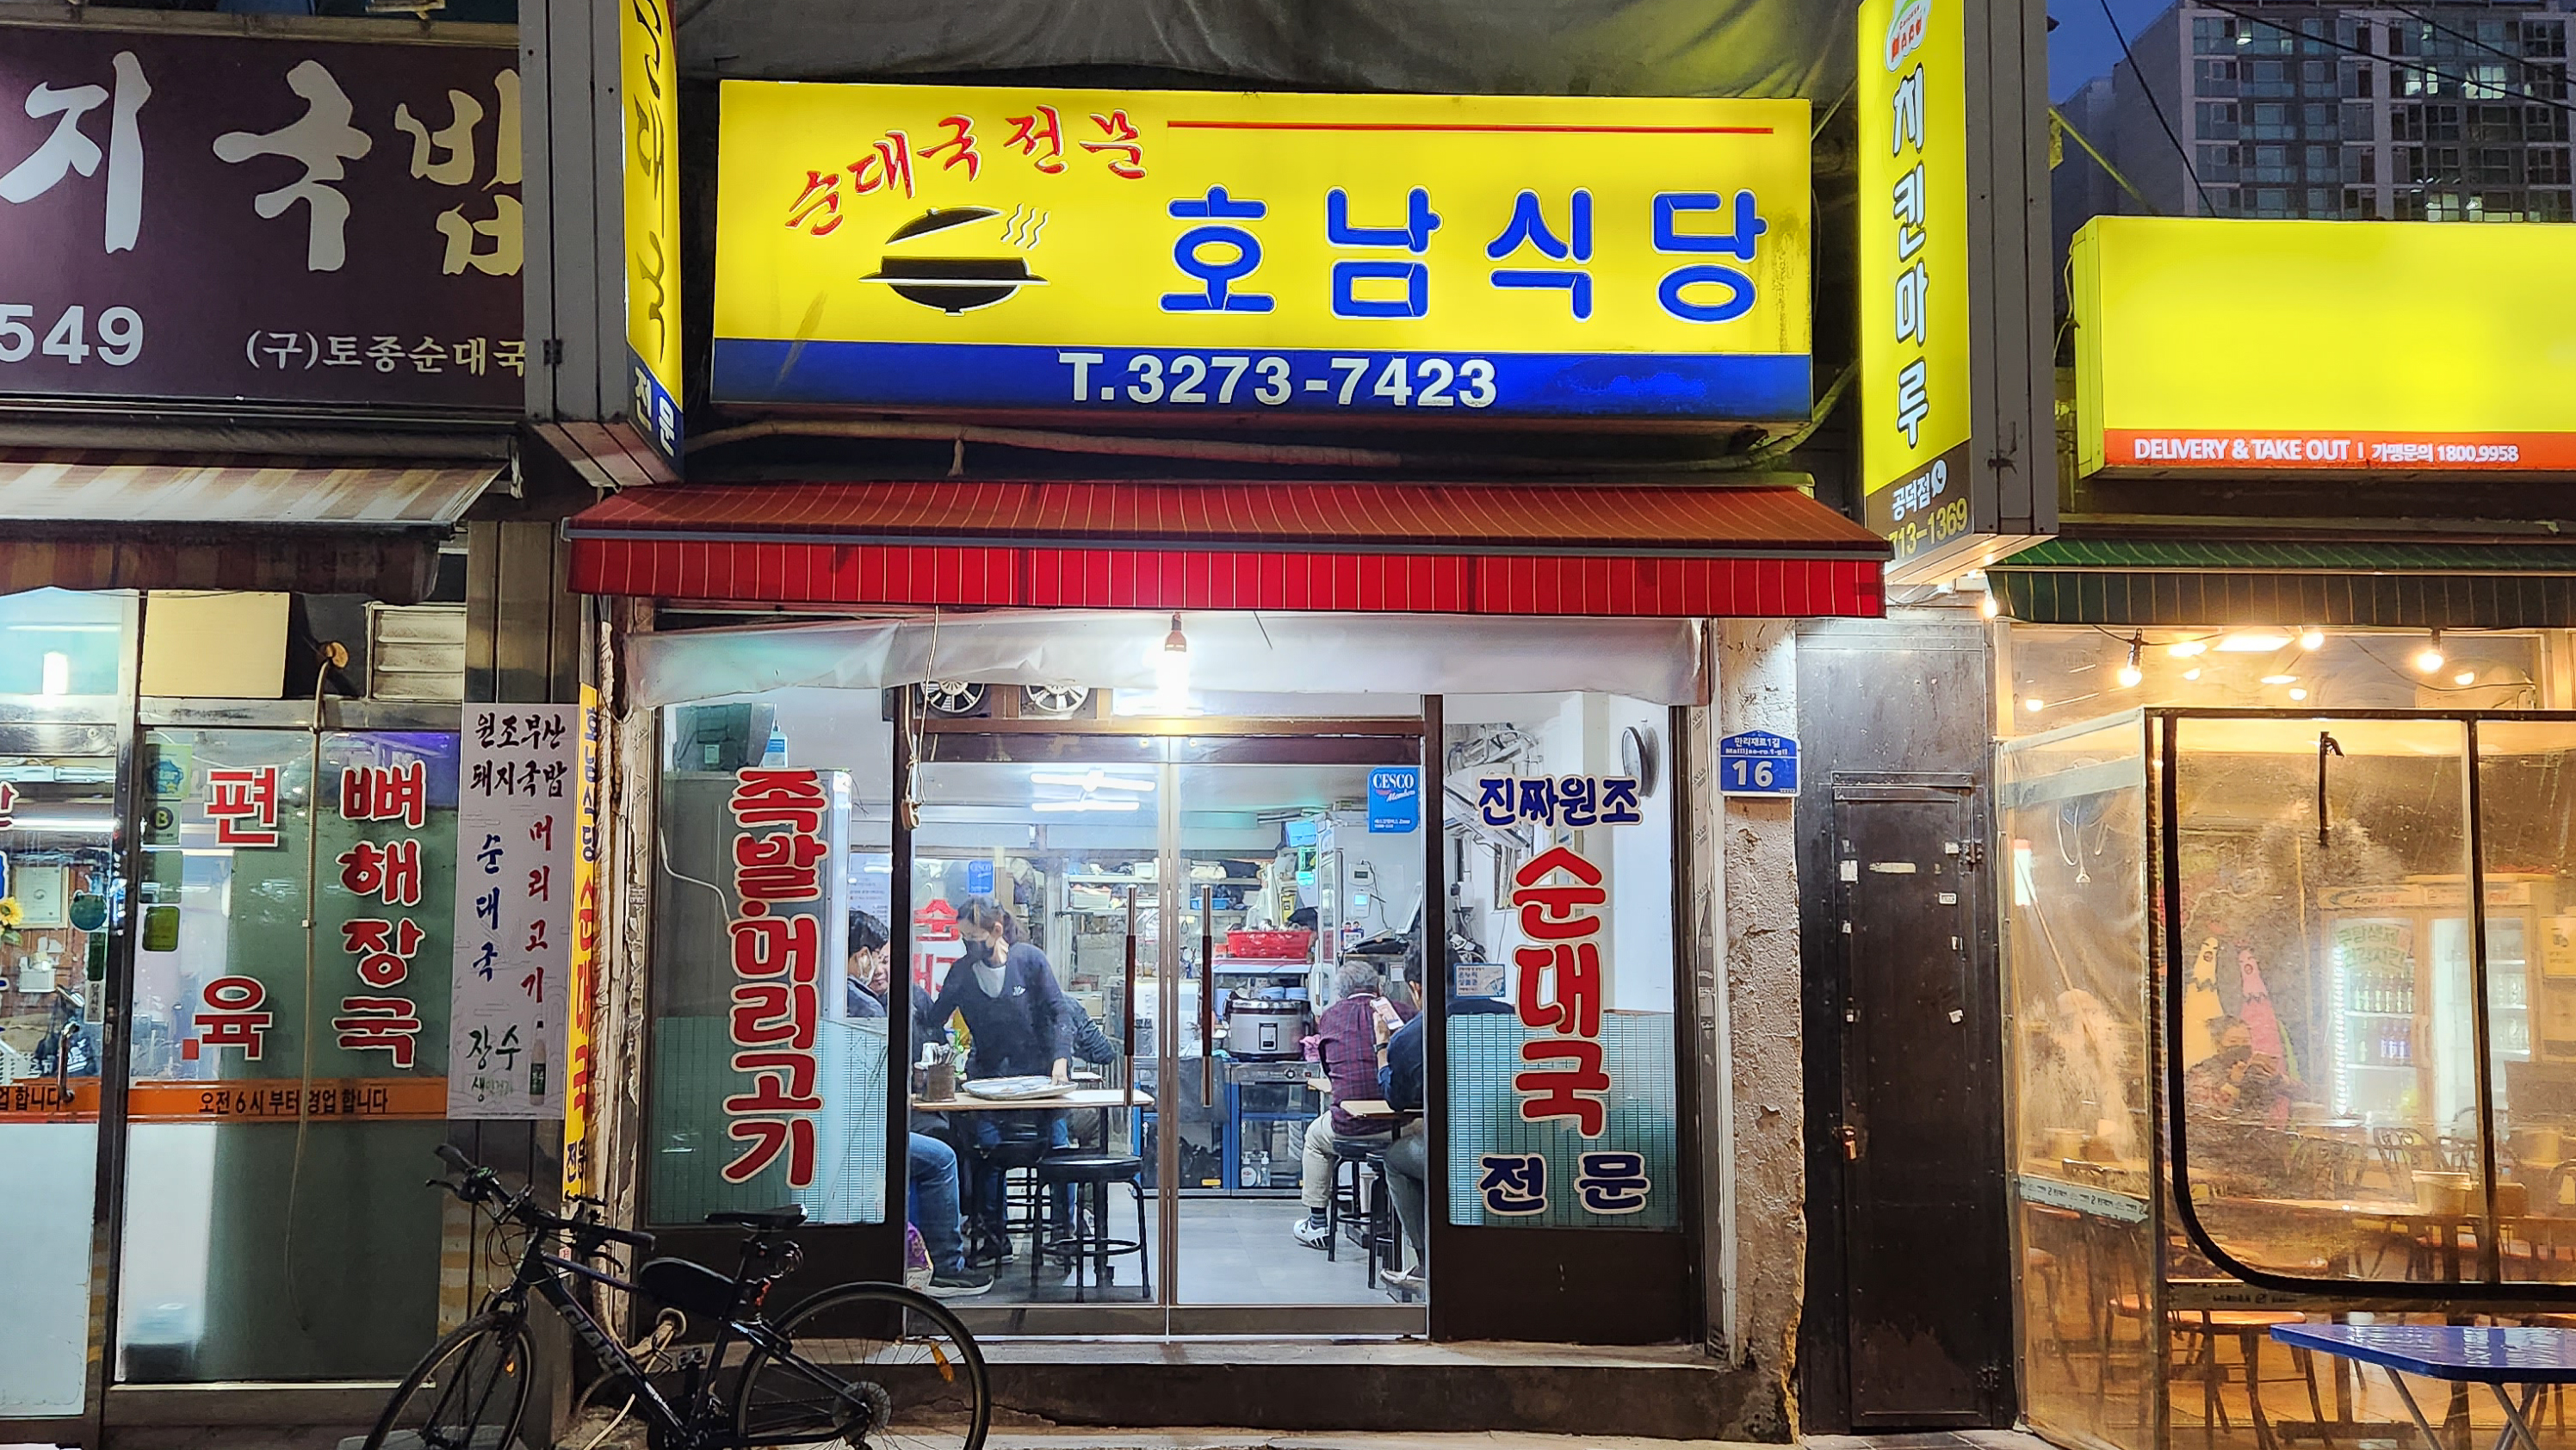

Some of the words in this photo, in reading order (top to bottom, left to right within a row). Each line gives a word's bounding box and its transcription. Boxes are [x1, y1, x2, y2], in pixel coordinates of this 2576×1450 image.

[784, 114, 982, 236] 순대국
[1003, 104, 1148, 180] 전문
[1158, 183, 1770, 324] 호남식당
[1892, 61, 1929, 450] 치킨마루
[0, 303, 144, 366] 549
[245, 329, 525, 377] (구)토종순대국
[635, 367, 675, 458] 전문
[2134, 438, 2229, 460] DELIVERY
[2232, 439, 2250, 460] &
[2251, 439, 2302, 461] TAKE
[2306, 440, 2351, 462] OUT
[2371, 443, 2434, 463] 가맹문의
[1892, 472, 1930, 522] 공덕점
[475, 712, 566, 750] 원조부산
[470, 759, 568, 797] 돼지국밥
[1372, 773, 1415, 789] CESCO
[1732, 759, 1774, 787] 16
[1477, 775, 1644, 827] 진짜원조
[331, 759, 427, 1069] 뼈해장국
[473, 833, 505, 982] 순대국
[521, 814, 554, 1003] 머리고기
[1512, 845, 1613, 1138] 순대국
[466, 1024, 523, 1071] 장수
[15, 1086, 61, 1112] 합니다
[199, 1090, 231, 1114] 오전
[342, 1088, 388, 1114] 합니다
[1477, 1151, 1651, 1216] 전문
